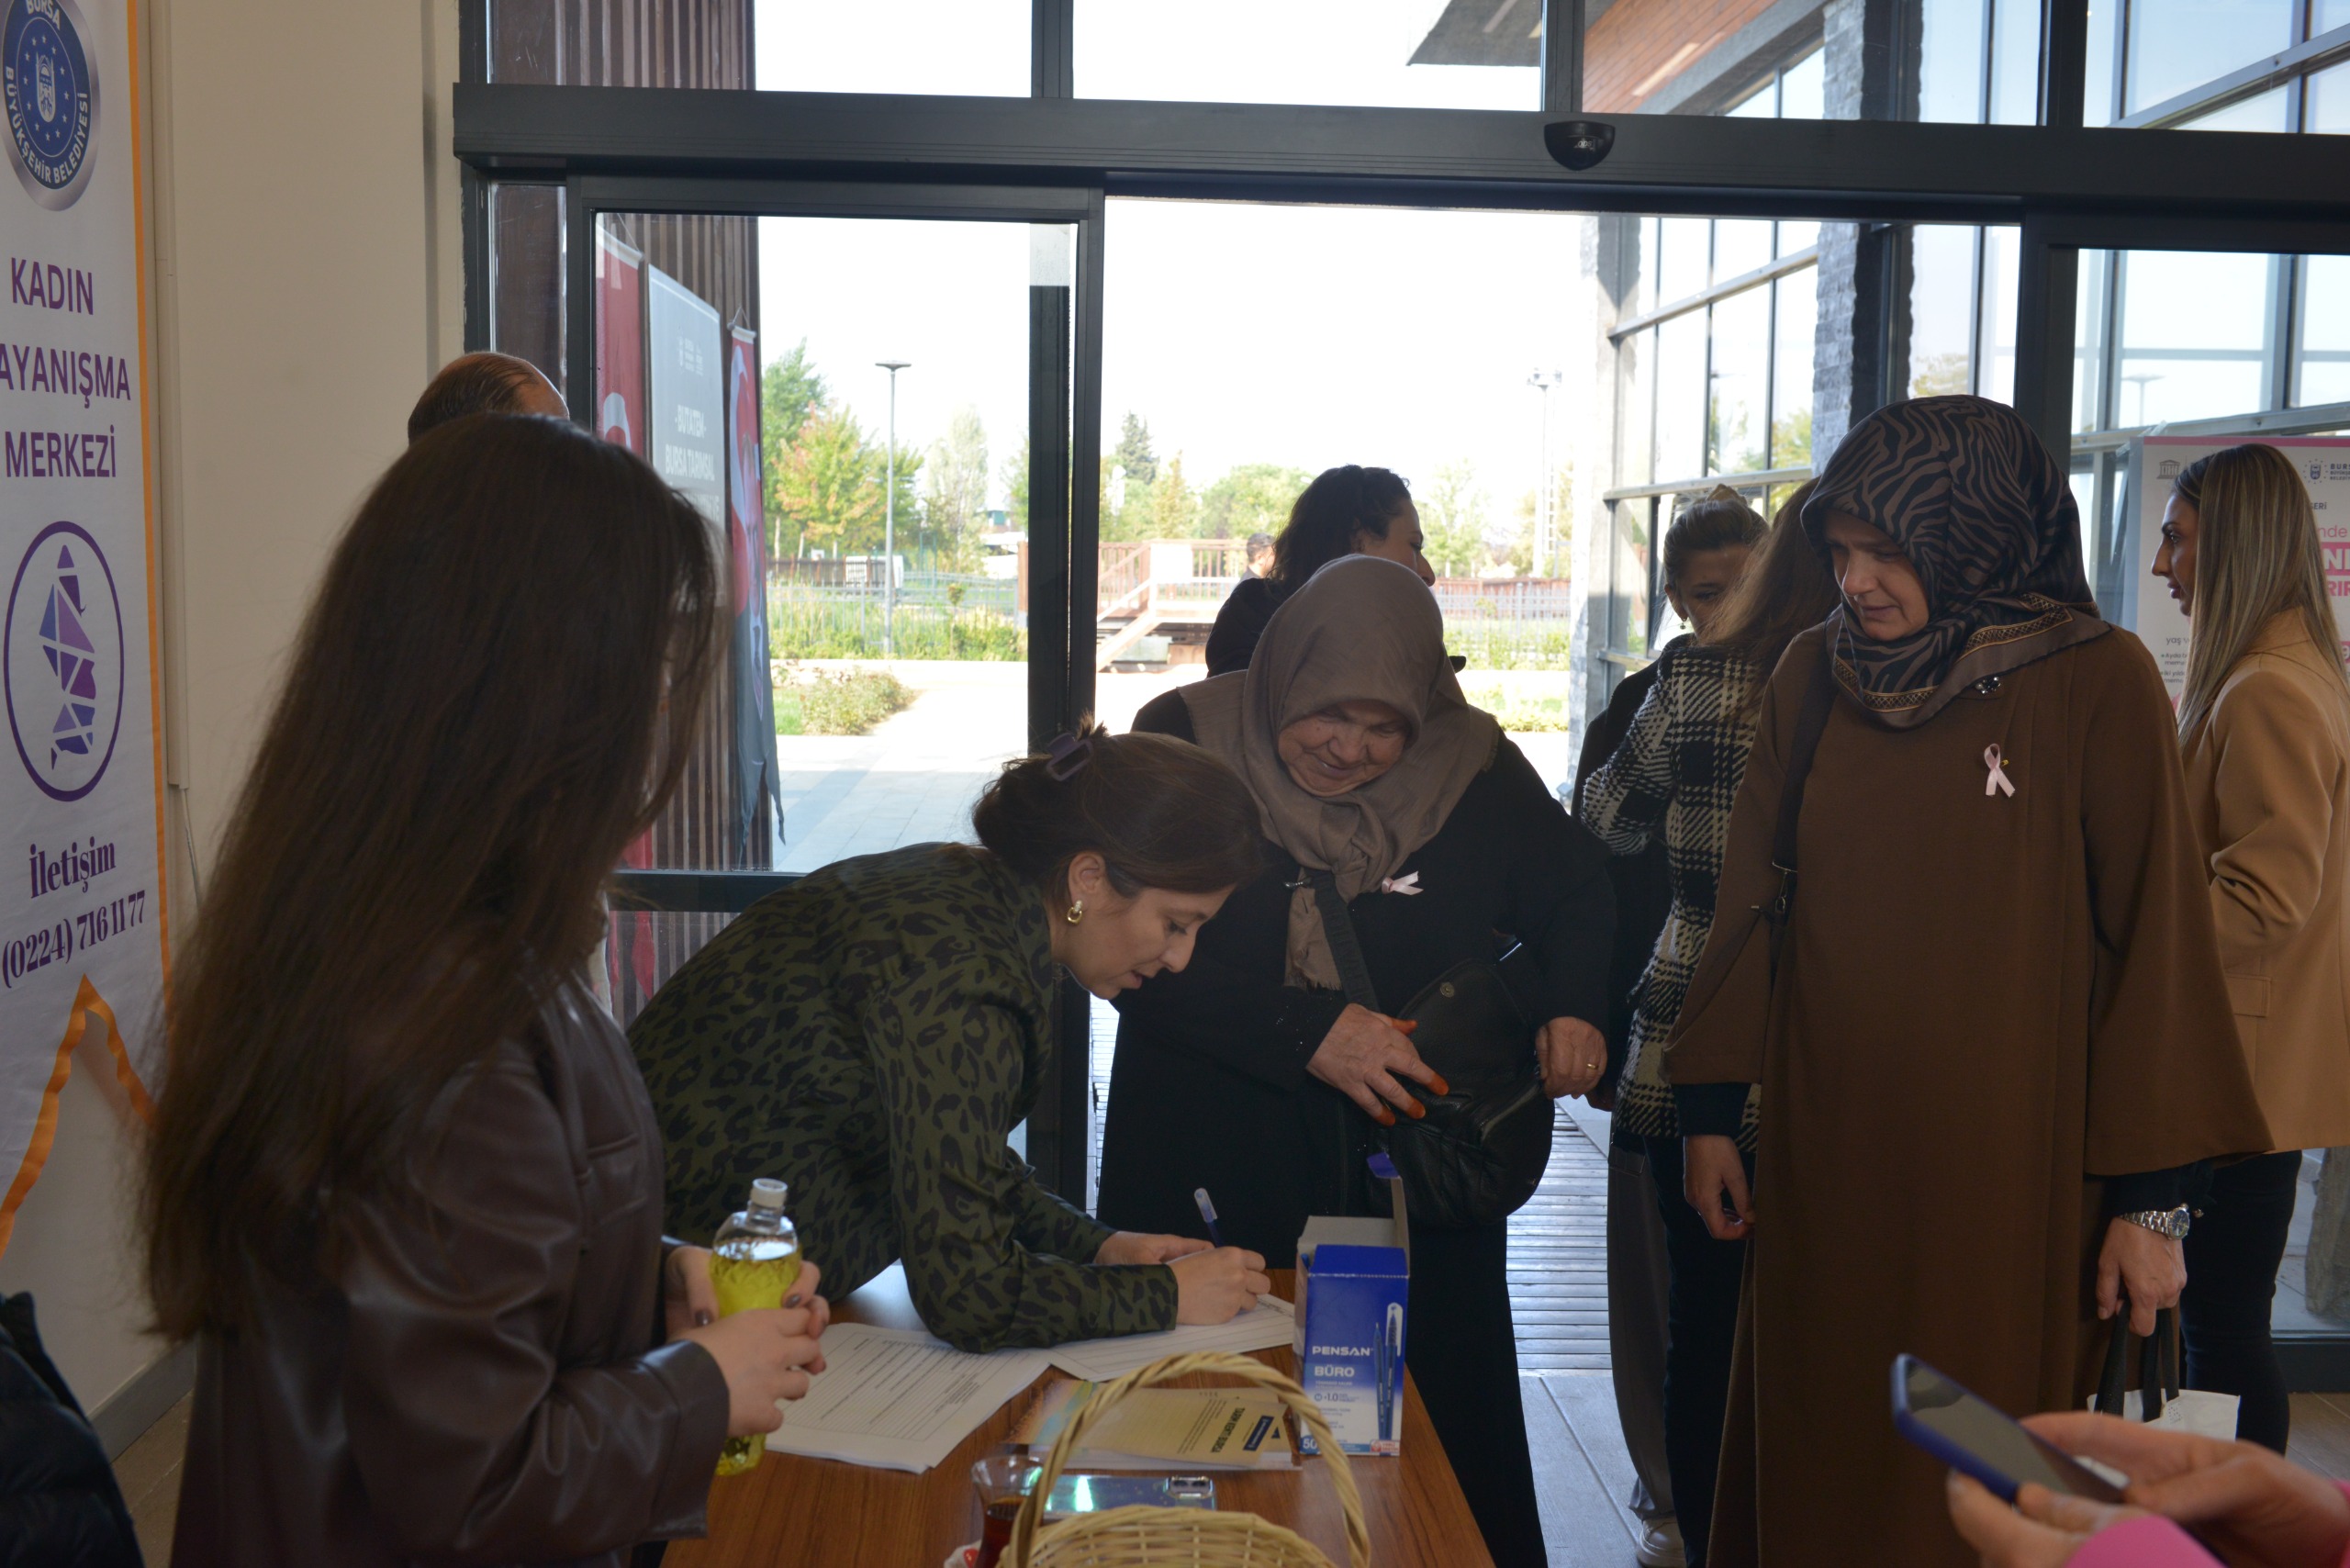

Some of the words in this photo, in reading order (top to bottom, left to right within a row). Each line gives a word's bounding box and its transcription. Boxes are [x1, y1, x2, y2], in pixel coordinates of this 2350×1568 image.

[6, 65, 52, 184] BÜYÜKŞEHİR
[53, 91, 89, 184] BELEDİYESİ
[11, 256, 94, 315] KADIN
[5, 423, 117, 477] MERKEZİ
[2318, 524, 2347, 538] nde
[2322, 548, 2350, 570] NI
[2327, 580, 2350, 597] RIR
[2165, 636, 2181, 646] yaş
[29, 836, 117, 899] İletişim
[2, 918, 73, 989] (0224)
[76, 905, 108, 950] 716
[110, 897, 127, 936] 11
[128, 890, 146, 927] 77
[1311, 1345, 1371, 1357] PENSAN
[1314, 1364, 1355, 1378] BÜRO
[1303, 1438, 1317, 1449] 50
